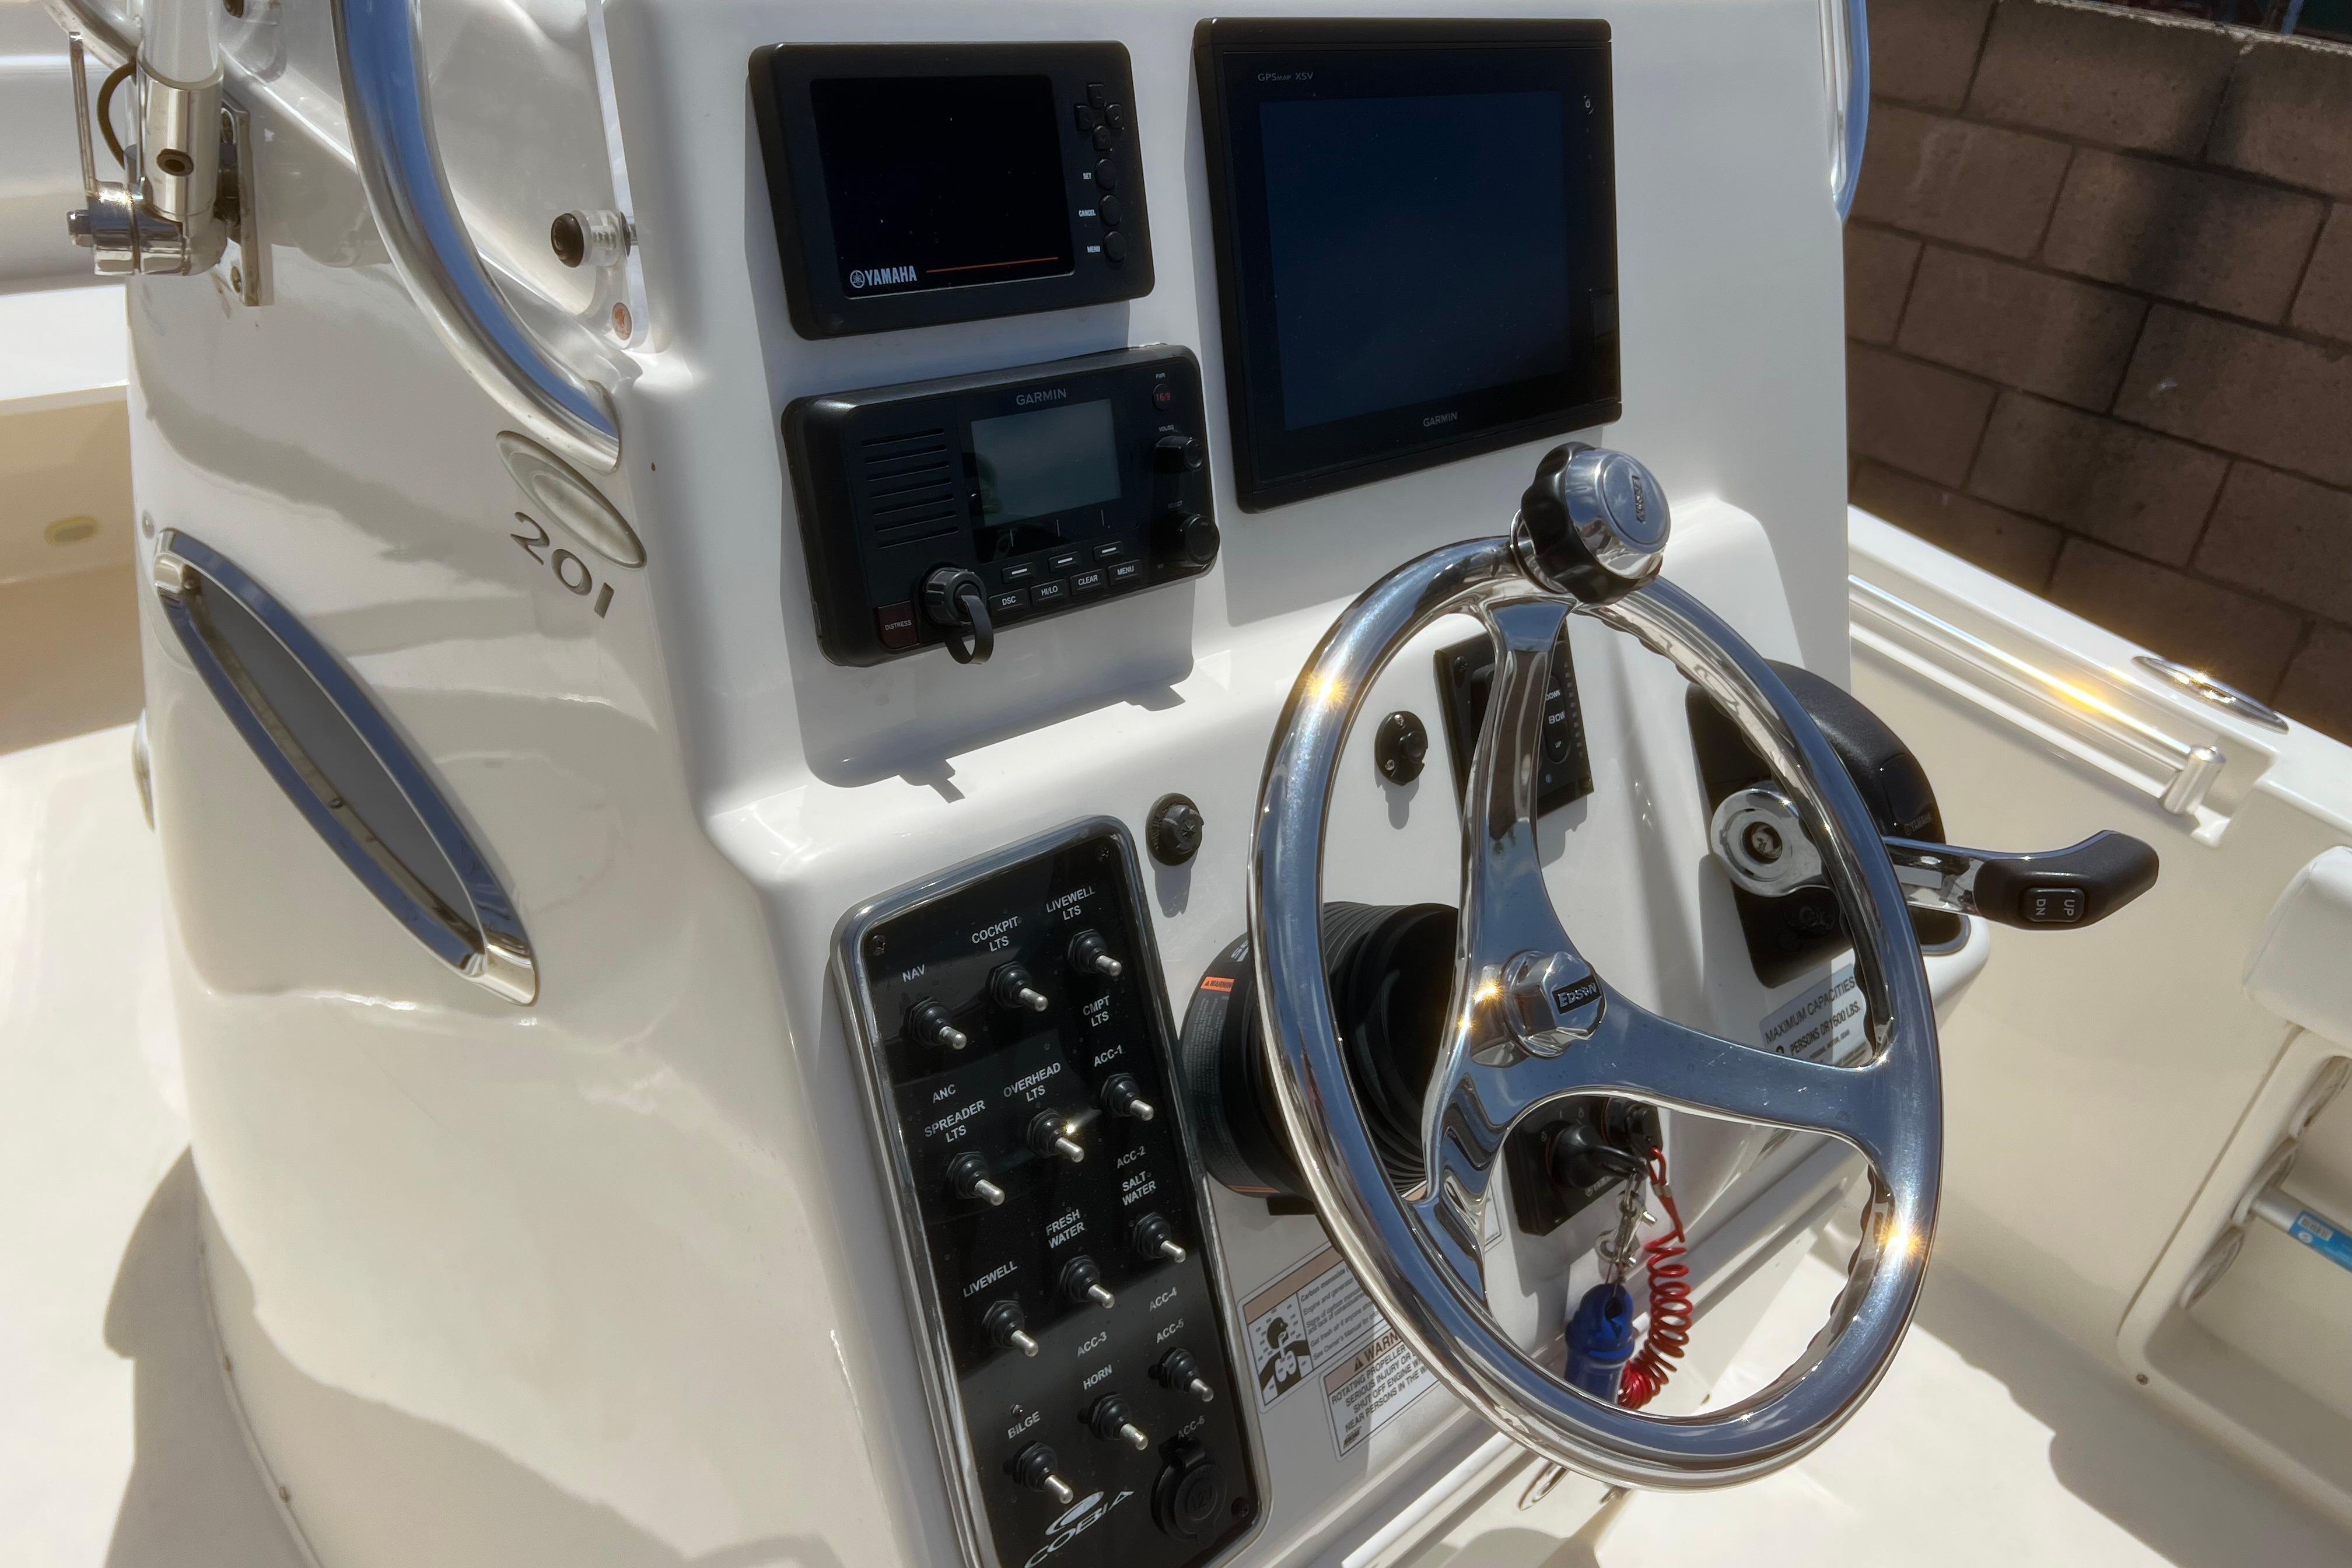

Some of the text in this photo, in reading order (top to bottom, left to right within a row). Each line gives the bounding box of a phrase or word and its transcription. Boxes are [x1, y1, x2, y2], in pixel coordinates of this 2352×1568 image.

[1295, 72, 1314, 80] XSV
[864, 265, 917, 286] YAMAHA
[1016, 387, 1067, 406] GARMIN
[1423, 411, 1458, 427] GARMIN
[510, 512, 614, 619] 201
[1117, 565, 1134, 576] MENU
[1041, 585, 1058, 596] HI/LO
[1078, 575, 1098, 586] CLEAR
[1002, 596, 1016, 606] DSC
[884, 619, 912, 631] DISTRESS
[1545, 690, 1560, 701] DOWN
[1548, 710, 1565, 724] BOW
[1046, 886, 1096, 913] LIVEWELL
[2036, 898, 2046, 916] DN
[2063, 899, 2075, 916] UP
[1062, 905, 1082, 921] LTS
[971, 915, 1019, 944] COCKPIT
[989, 936, 1009, 952] LTS
[902, 964, 926, 983] NAV
[1083, 995, 1110, 1016] CMPT
[1558, 982, 1597, 1007] EDSON
[1091, 1010, 1109, 1027] LTS
[1765, 976, 1856, 1044] MAXIMUM CAPACITIES
[1790, 1027, 1820, 1056] PERSONS
[1829, 1010, 1846, 1030] 1600
[1846, 1000, 1861, 1018] LBS.
[1094, 1045, 1124, 1068] ACC-1
[1003, 1062, 1061, 1097] OVERHEAD
[933, 1084, 956, 1104] ANC
[1026, 1084, 1045, 1102] LTS
[924, 1100, 986, 1138] SPREADER
[946, 1125, 967, 1143] LTS
[1116, 1146, 1146, 1169] ACC-2
[1122, 1171, 1147, 1192] SALT
[1122, 1180, 1157, 1206] WATER
[1045, 1209, 1081, 1236] FRESH
[1048, 1222, 1086, 1249] WATER
[963, 1260, 1018, 1298] LIVEWELL
[1149, 1286, 1177, 1312] ACC-4
[1300, 1286, 1320, 1303] Carbon
[1156, 1318, 1184, 1343] ACC-5
[1077, 1331, 1108, 1357] ACC-3
[1083, 1364, 1112, 1390] HORN
[1332, 1344, 1406, 1405] ROTATING PROPELLER
[1345, 1380, 1376, 1407] SERIOUS
[1376, 1359, 1400, 1384] INJURY
[1401, 1352, 1411, 1365] OR
[1353, 1394, 1371, 1413] SHUT
[1372, 1383, 1386, 1398] OFF
[1387, 1364, 1412, 1388] ENGINE
[1345, 1372, 1419, 1433] NEAR PERSONS IN THE
[1007, 1410, 1041, 1440] BILGE
[1177, 1415, 1205, 1441] ACC-6
[1024, 1491, 1135, 1568] COBIA
